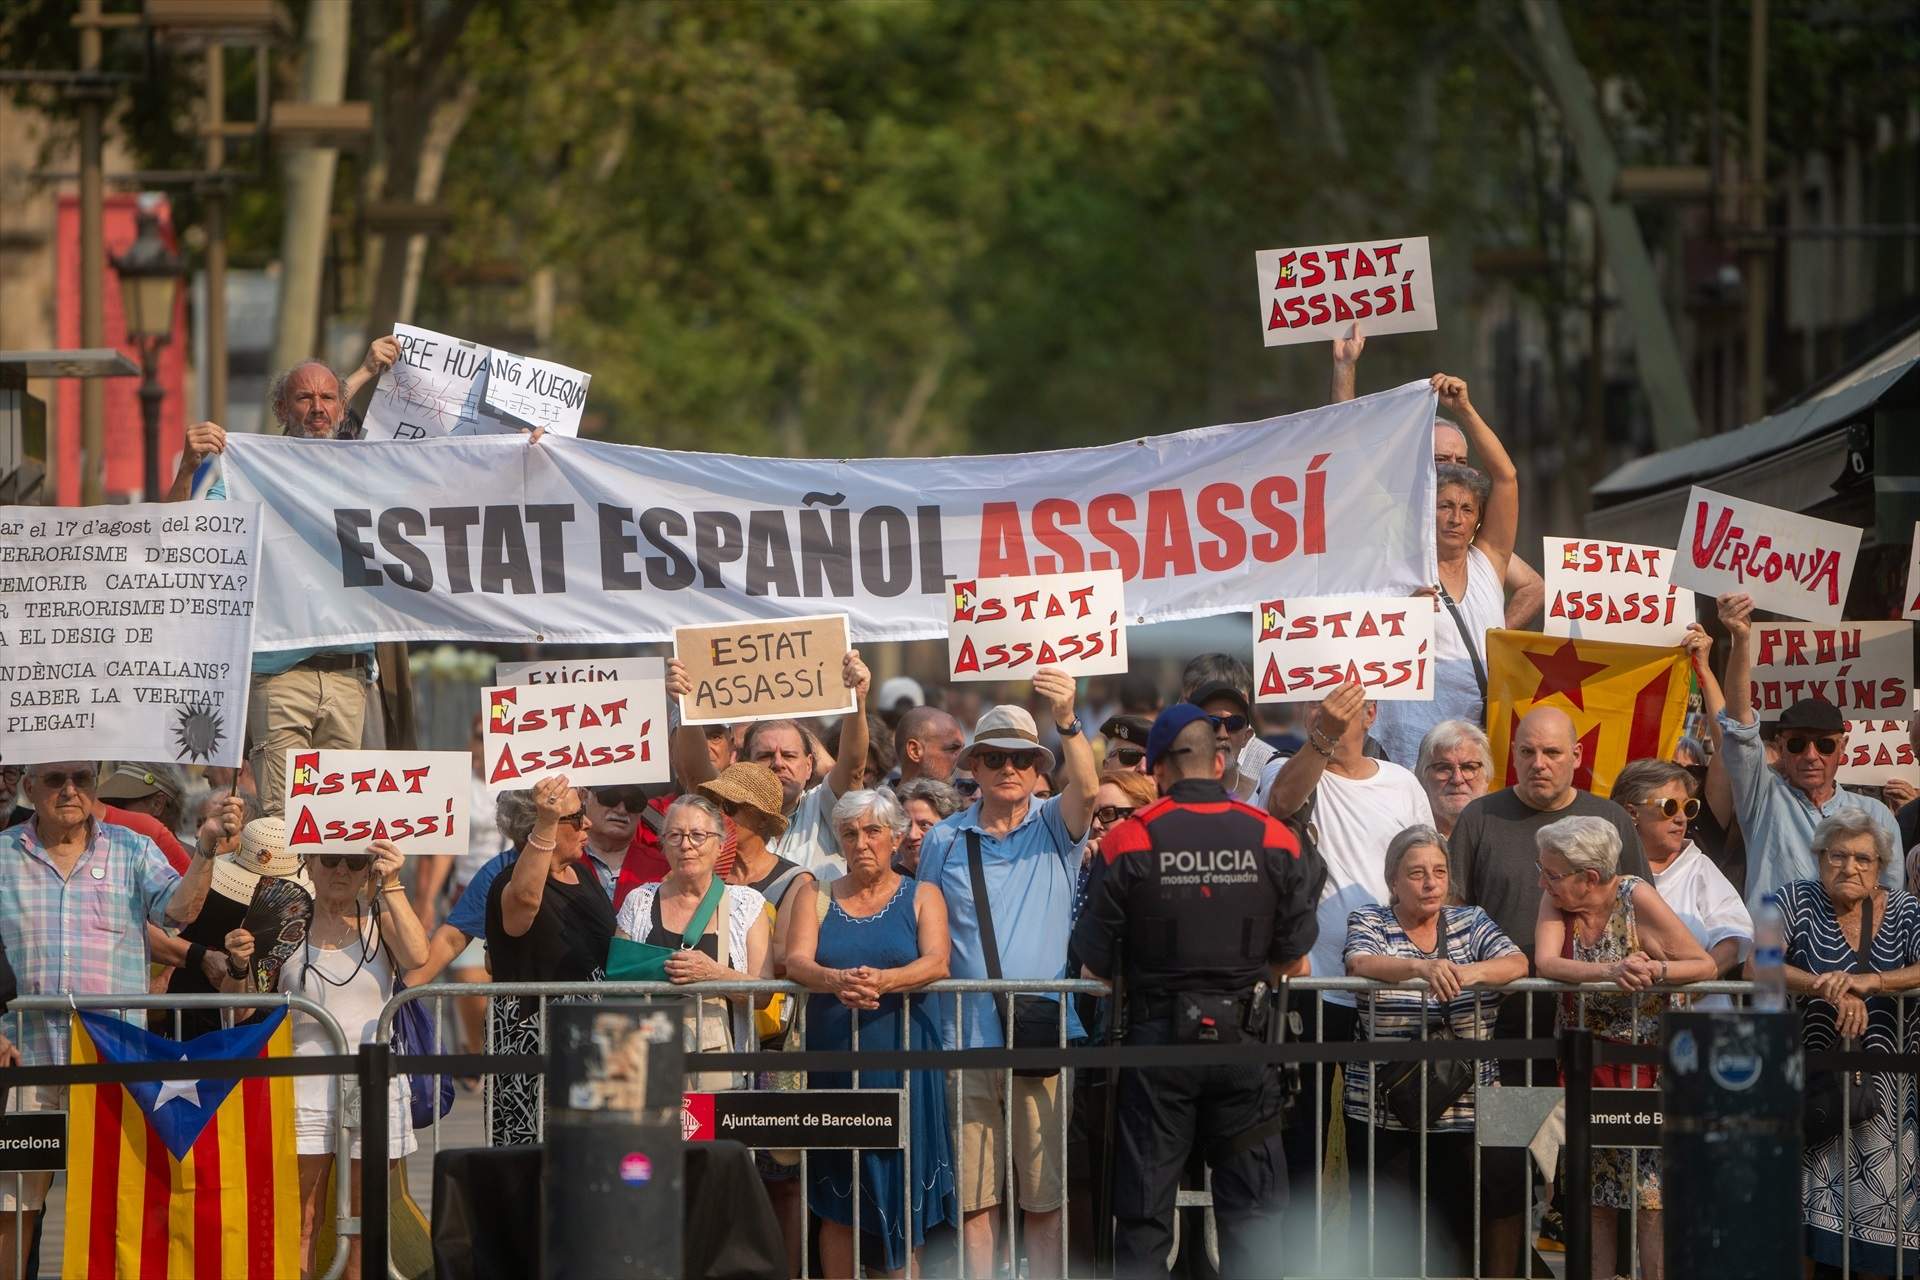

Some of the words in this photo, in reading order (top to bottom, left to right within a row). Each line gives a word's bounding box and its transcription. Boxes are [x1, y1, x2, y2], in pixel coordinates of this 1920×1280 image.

[275, 243, 403, 289] ESTAT
[268, 269, 416, 330] ASSASSÍ
[526, 367, 587, 410] XUEQIN
[30, 522, 47, 537] el
[56, 521, 78, 536] 17
[83, 518, 151, 537] d'agost
[162, 517, 190, 533] del
[195, 516, 248, 535] 2017.
[333, 503, 576, 594] ESTAT
[597, 491, 957, 598] ESPAÑOL
[978, 452, 1334, 583] ASSASSÍ
[0, 546, 128, 562] ERRORISME
[145, 547, 248, 565] D'ESCOLA
[1562, 541, 1660, 578] ESTAT
[0, 575, 87, 593] EMORIR
[106, 573, 248, 592] CATALUNYA?
[952, 580, 1095, 624] ESTAT
[25, 600, 164, 618] TERRORISME
[169, 598, 255, 617] D'ESTAT
[1258, 600, 1407, 643] ESTAT
[1549, 583, 1678, 626] ASSASSÍ
[19, 629, 46, 645] EL
[51, 628, 116, 645] DESIG
[125, 628, 153, 644] DE
[711, 630, 813, 666] ESTAT
[953, 610, 1118, 676] ASSASSÍ
[1757, 628, 1861, 667] PROU
[106, 661, 231, 680] CATALANS?
[1258, 639, 1428, 696] ASSASSÍ
[10, 688, 80, 707] SABER
[91, 687, 120, 704] LA
[133, 688, 225, 707] VERITAT
[489, 687, 628, 735] ESTAT
[7, 712, 95, 733] PLEGAT!
[489, 718, 651, 784] ASSASSÍ
[290, 751, 431, 798] ESTAT
[289, 797, 455, 846] ASSASSÍ
[1160, 850, 1258, 873] POLICIA
[1161, 875, 1201, 885] mossos
[1203, 872, 1259, 886] d'esquadra
[722, 1113, 800, 1129] Ajuntament
[803, 1113, 819, 1127] de
[821, 1113, 893, 1128] Barcelona
[1634, 1112, 1650, 1124] de
